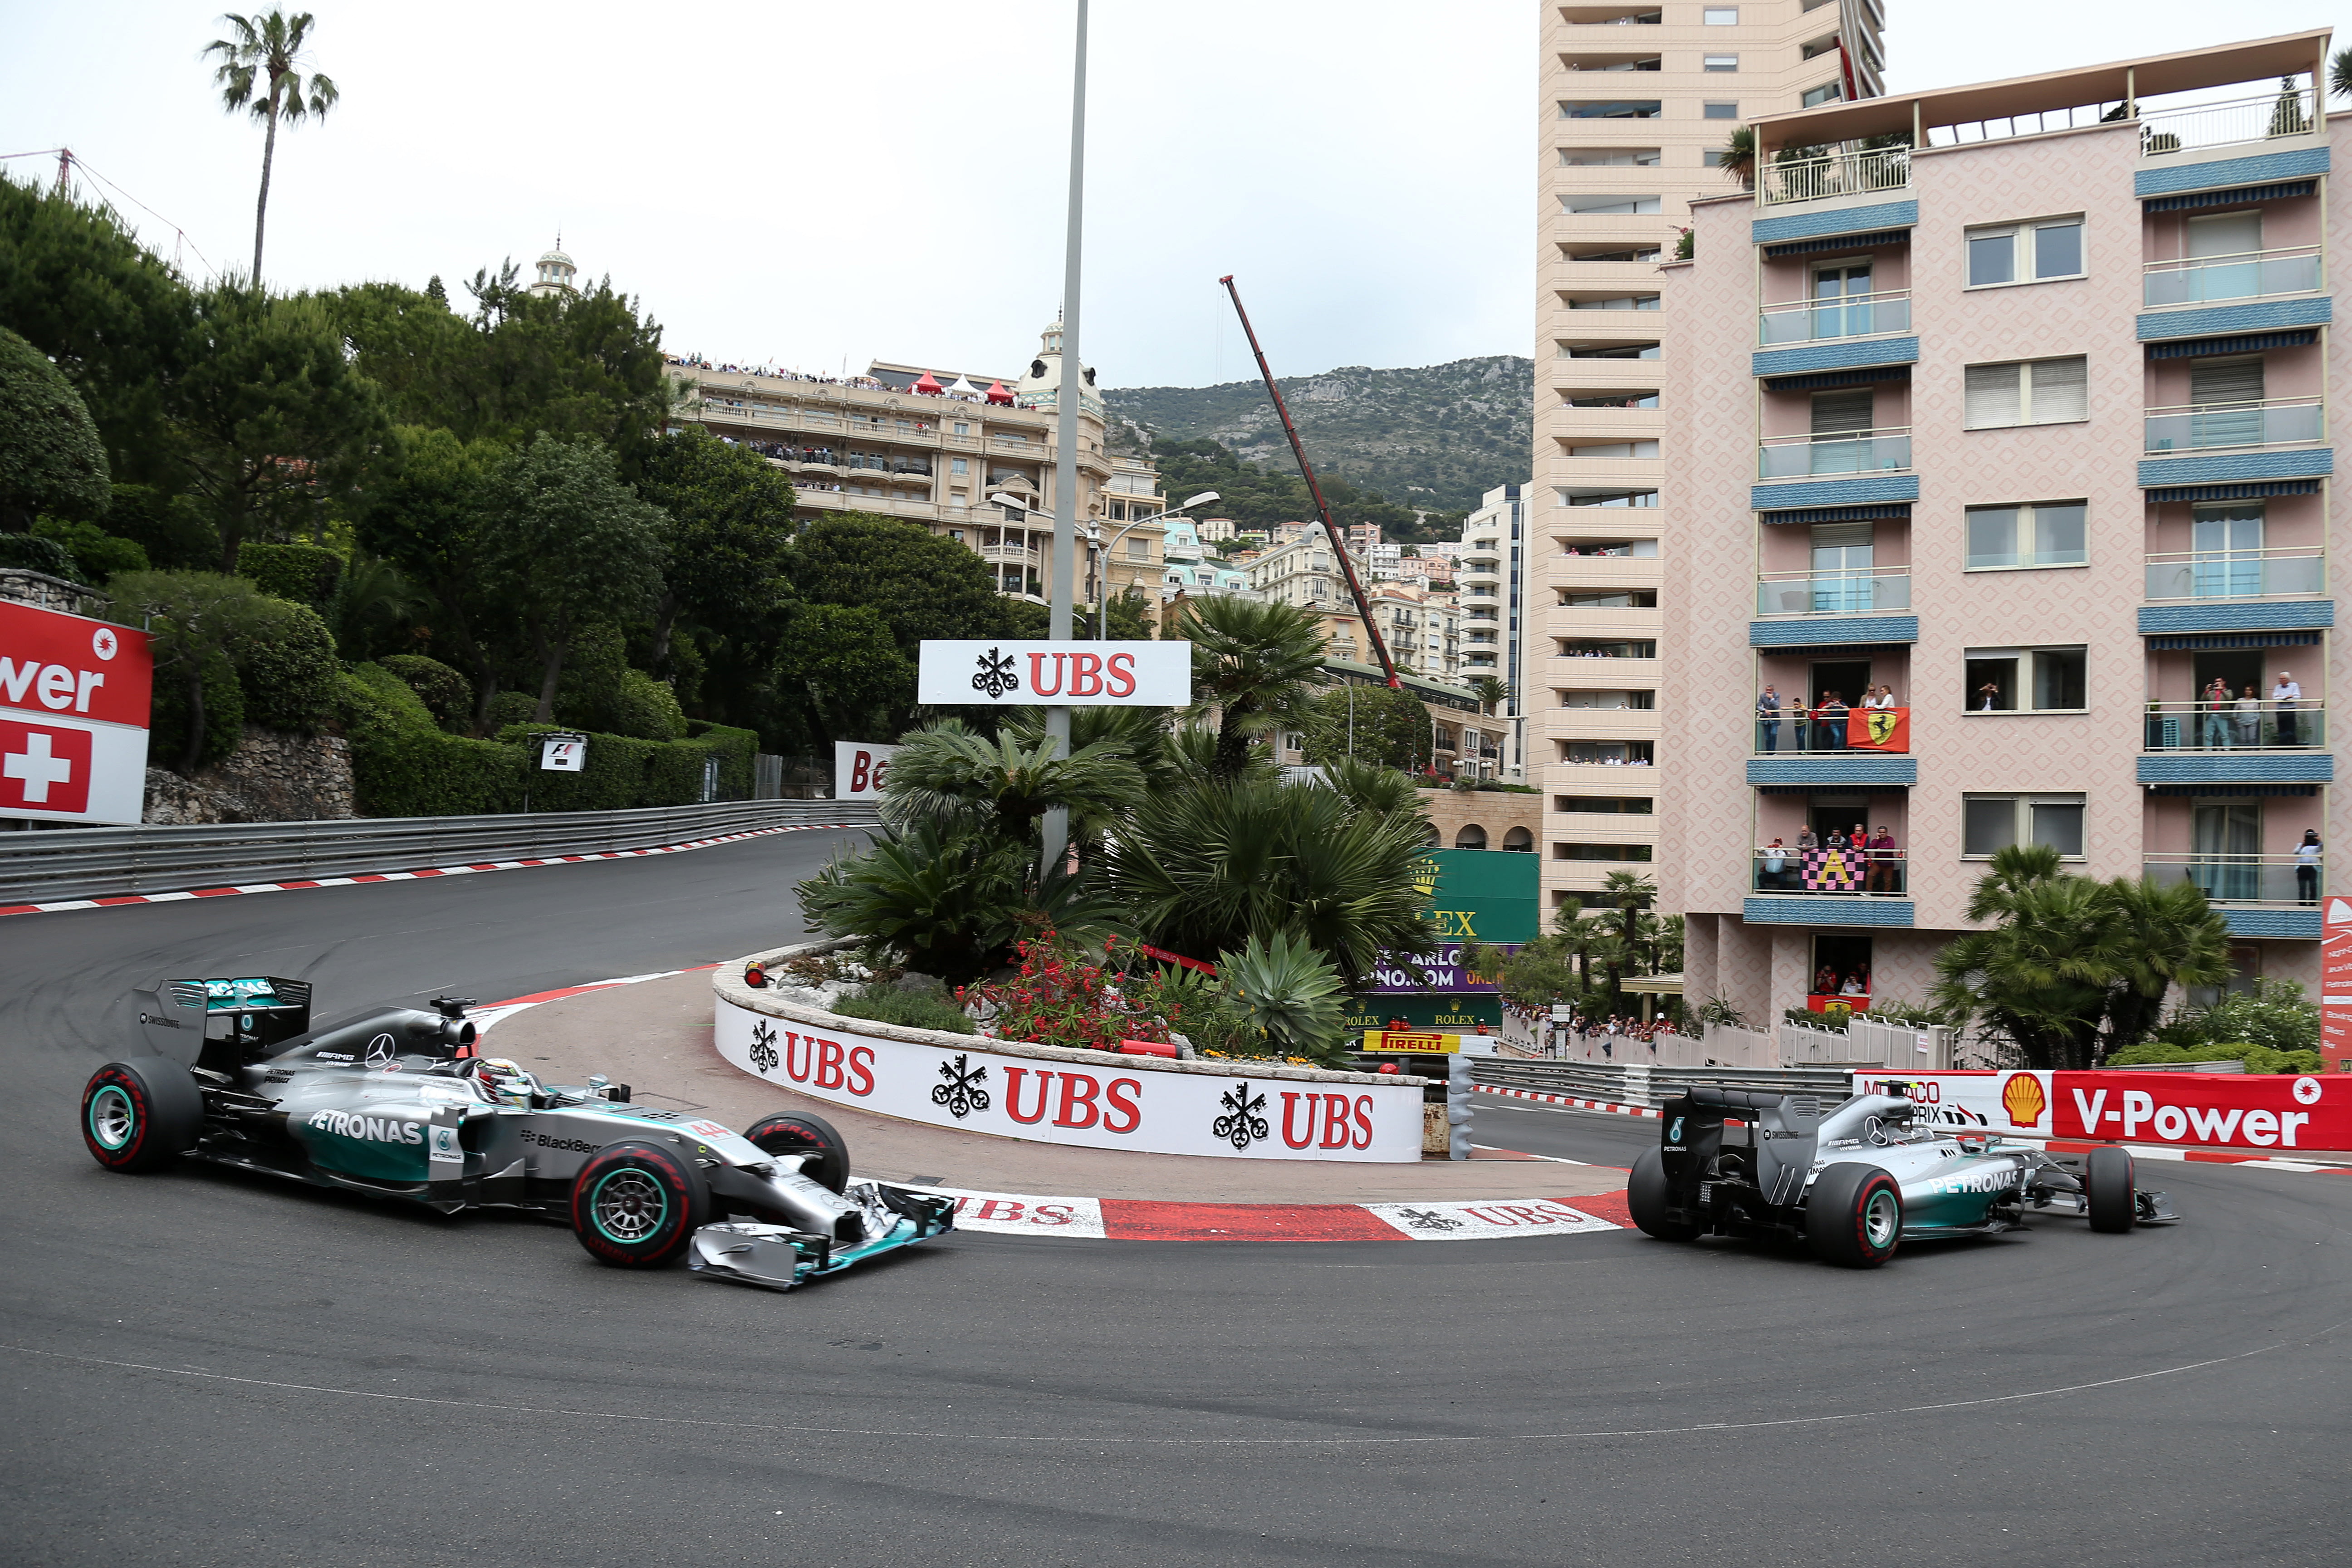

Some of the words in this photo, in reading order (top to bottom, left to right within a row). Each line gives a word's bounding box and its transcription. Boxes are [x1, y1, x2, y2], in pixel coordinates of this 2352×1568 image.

[1027, 652, 1135, 697] UBS
[1815, 850, 1853, 883] A
[1155, 950, 1176, 961] PUBLIC
[1345, 1016, 1379, 1026] ROLEX
[1435, 1015, 1475, 1024] ROLEX
[1381, 1032, 1442, 1051] PIRELLI
[785, 1031, 876, 1097] UBS
[1003, 1066, 1142, 1134] UBS
[1280, 1092, 1374, 1151] UBS
[1913, 1106, 1941, 1124] PRIX
[2072, 1088, 2309, 1147] V-Power
[308, 1108, 424, 1145] PETRONAS
[691, 1122, 732, 1138] 44
[761, 1123, 818, 1141] ZERO
[537, 1133, 602, 1154] BlackBer
[1927, 1170, 2018, 1194] PETRONAS
[1457, 1205, 1585, 1226] UBS
